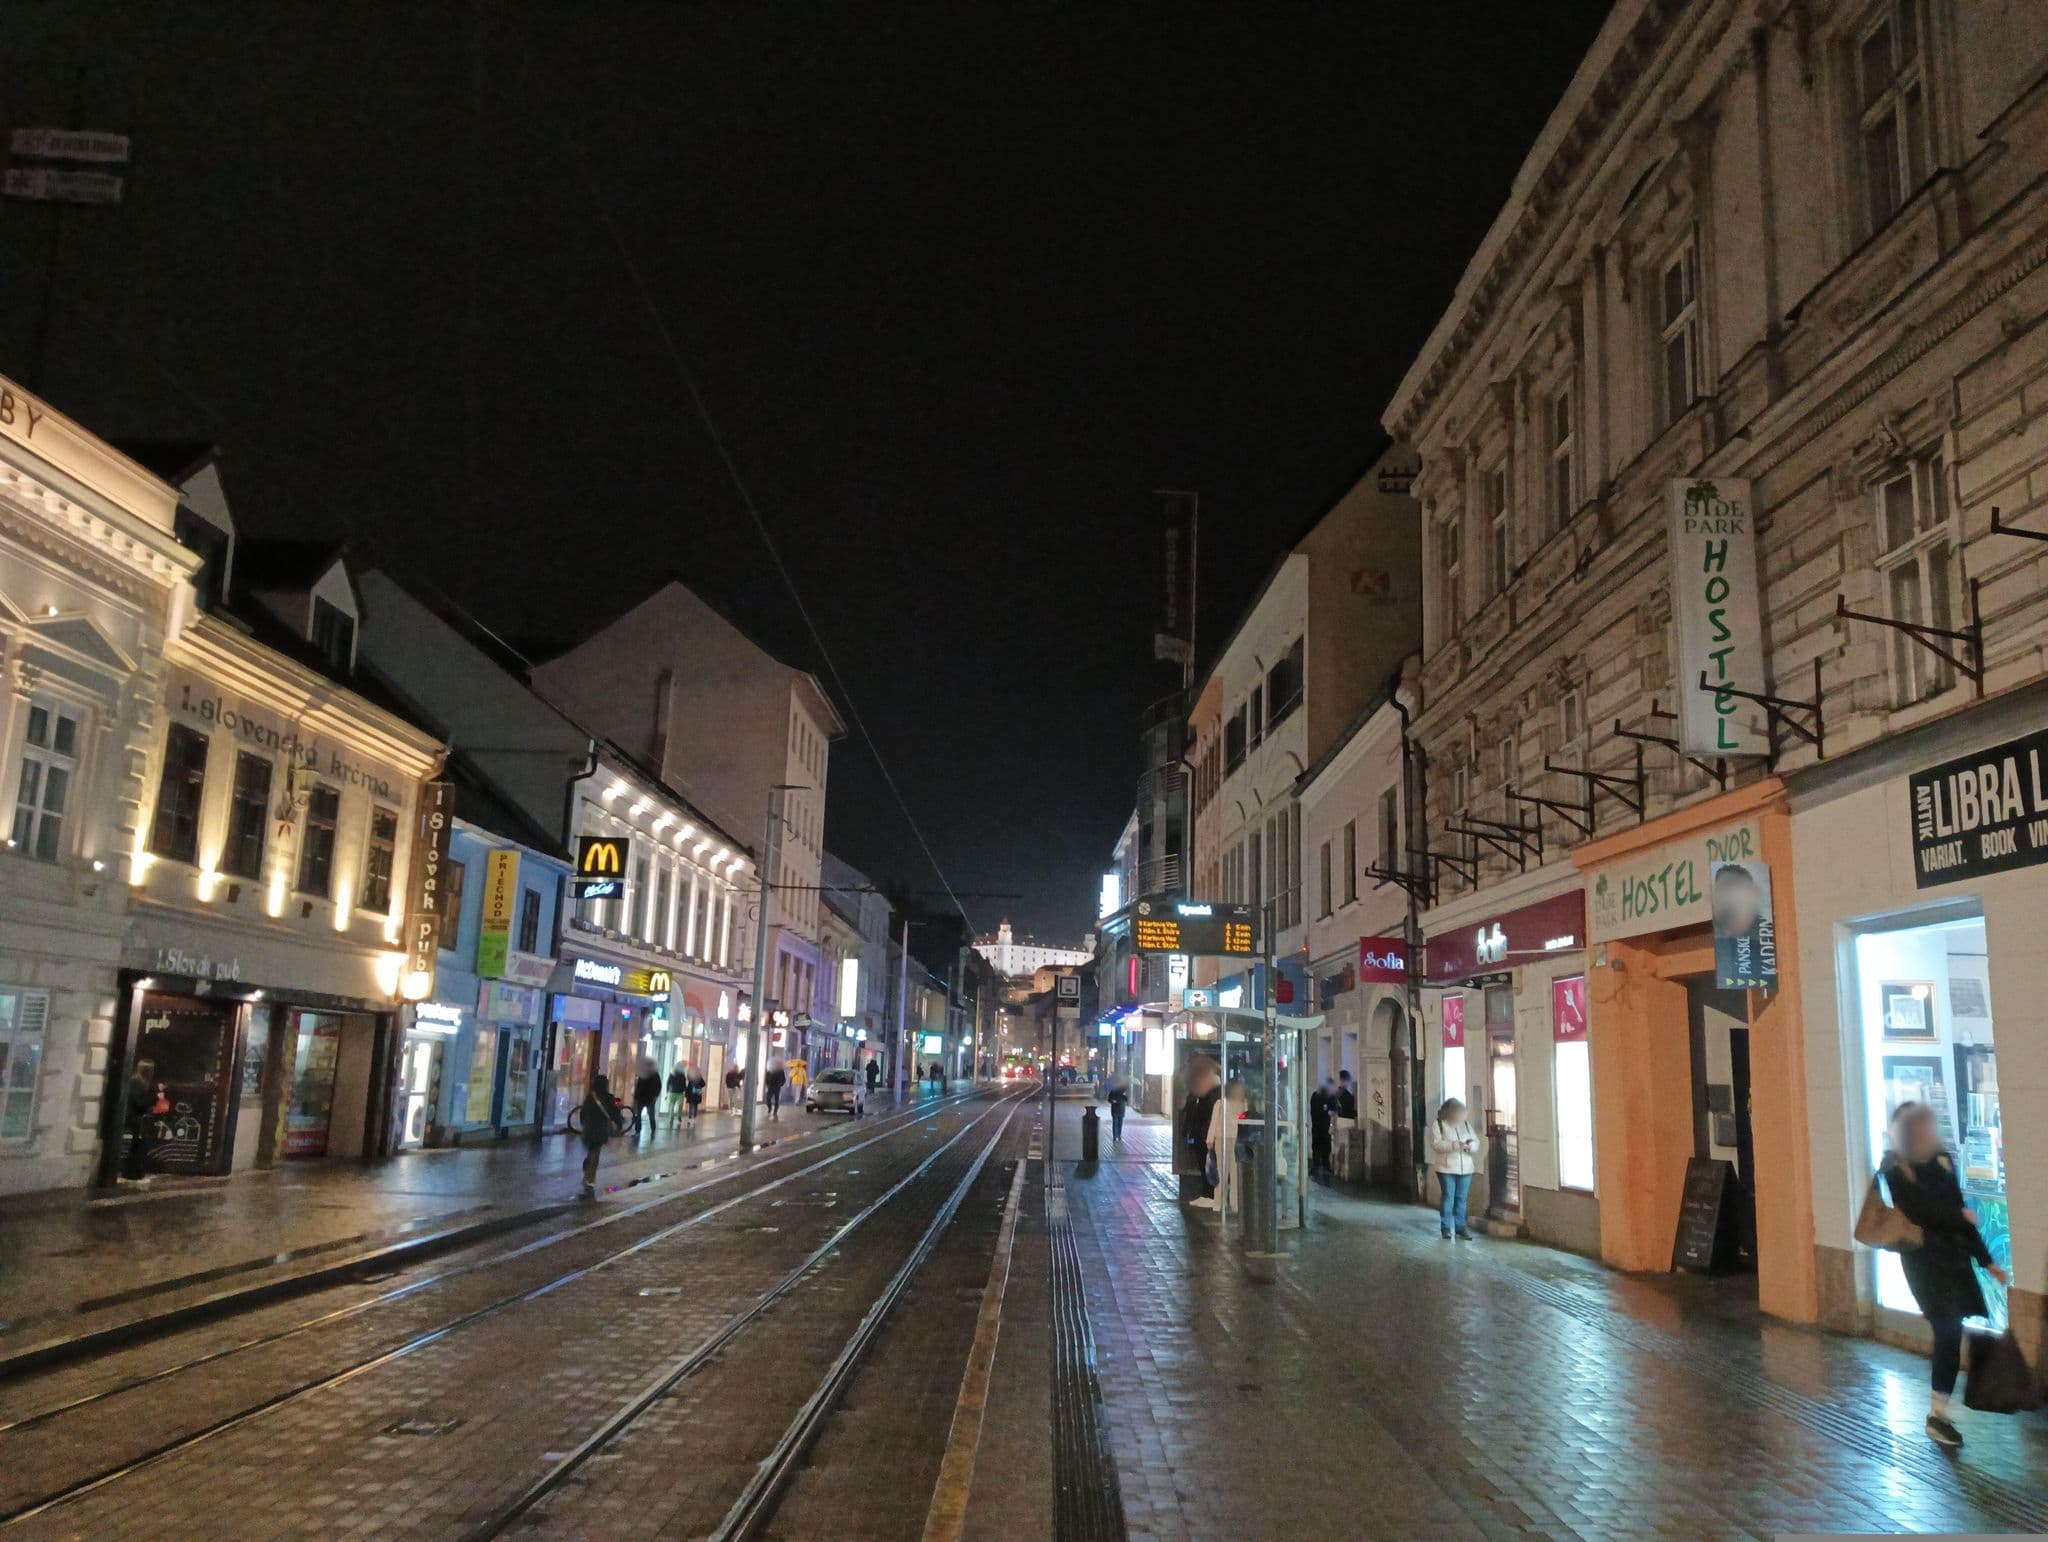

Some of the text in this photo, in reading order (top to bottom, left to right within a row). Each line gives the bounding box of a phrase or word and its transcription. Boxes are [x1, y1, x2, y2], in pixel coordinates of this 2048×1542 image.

[1684, 519, 1744, 534] PARK
[1703, 537, 1739, 750] HOSTEL
[1916, 785, 1934, 841] ANTIK
[1933, 756, 2025, 838] LIBRA
[1921, 840, 1968, 873] VARIAT.
[1981, 827, 2018, 860] BOOK
[1622, 860, 1702, 921] HOSTEL
[215, 959, 240, 980] pub
[415, 922, 432, 972] pub
[145, 1011, 171, 1034] pub
